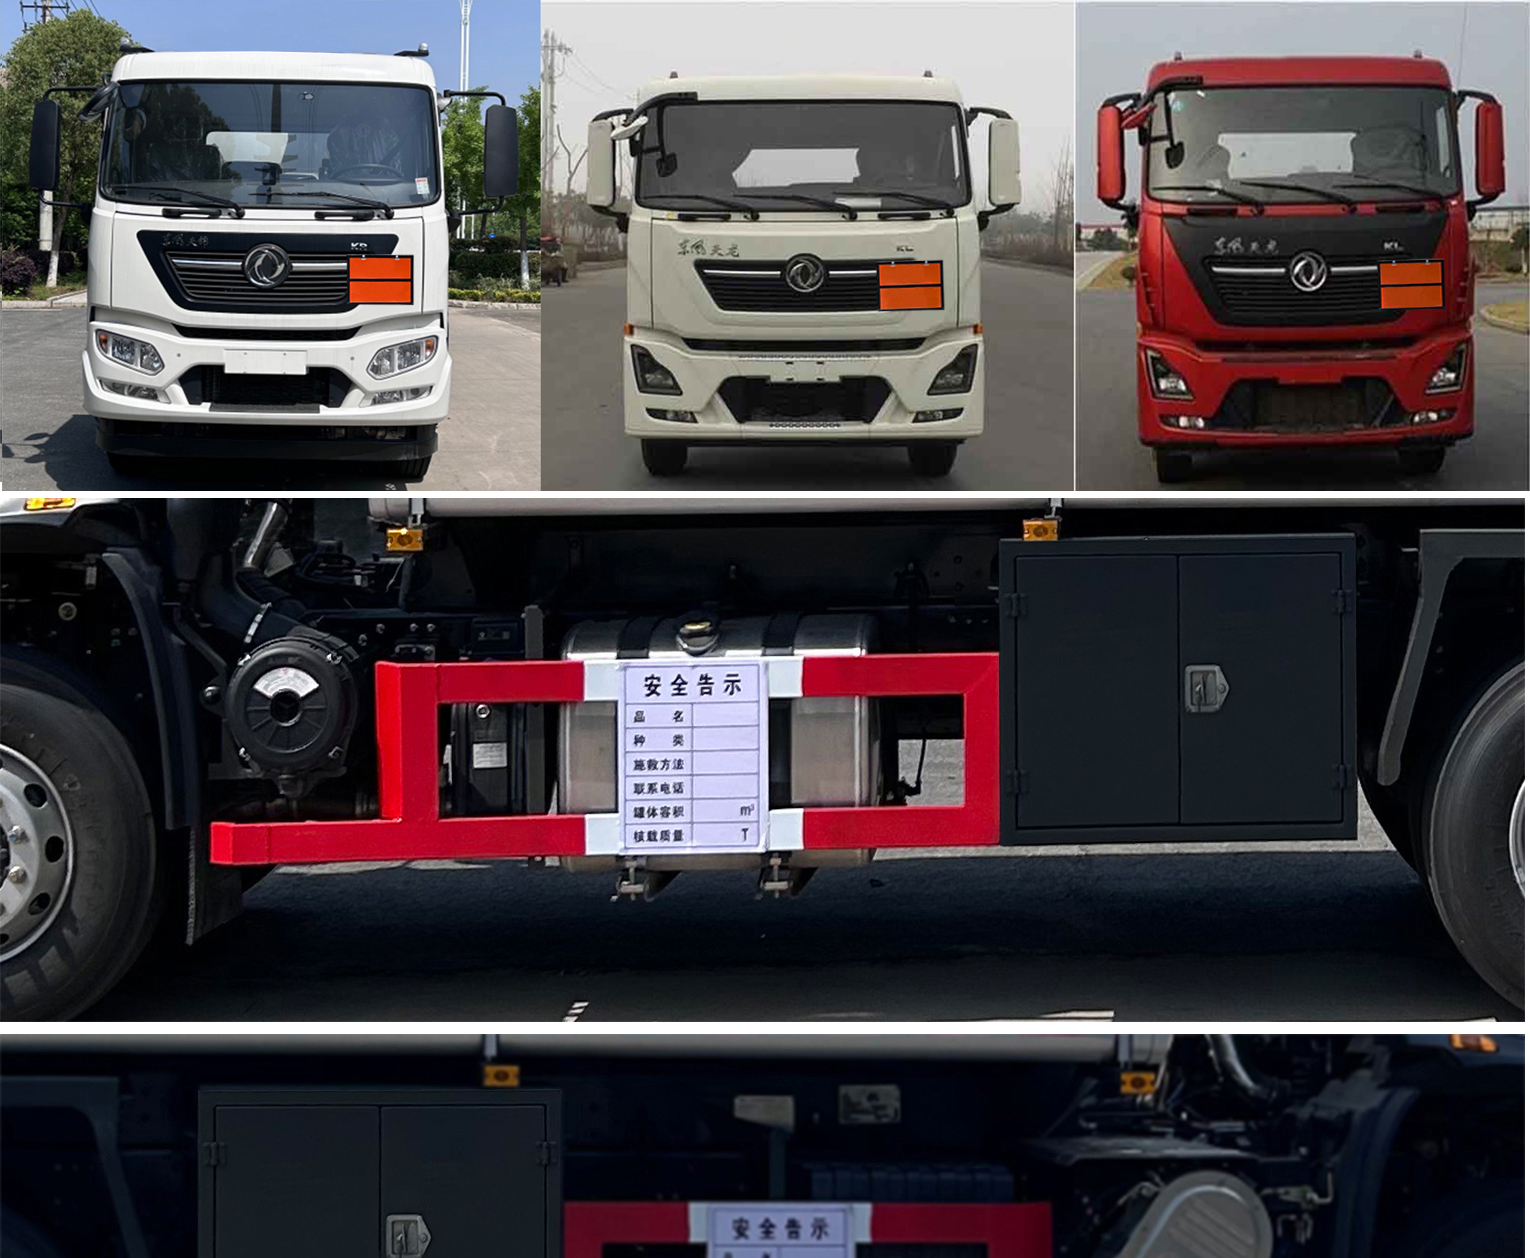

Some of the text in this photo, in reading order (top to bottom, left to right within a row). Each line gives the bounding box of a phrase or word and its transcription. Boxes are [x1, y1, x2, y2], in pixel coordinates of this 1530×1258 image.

[644, 673, 742, 697] 安全告示
[633, 781, 684, 795] 联系电话
[741, 828, 749, 841] T
[732, 1217, 830, 1240] 安全告示
